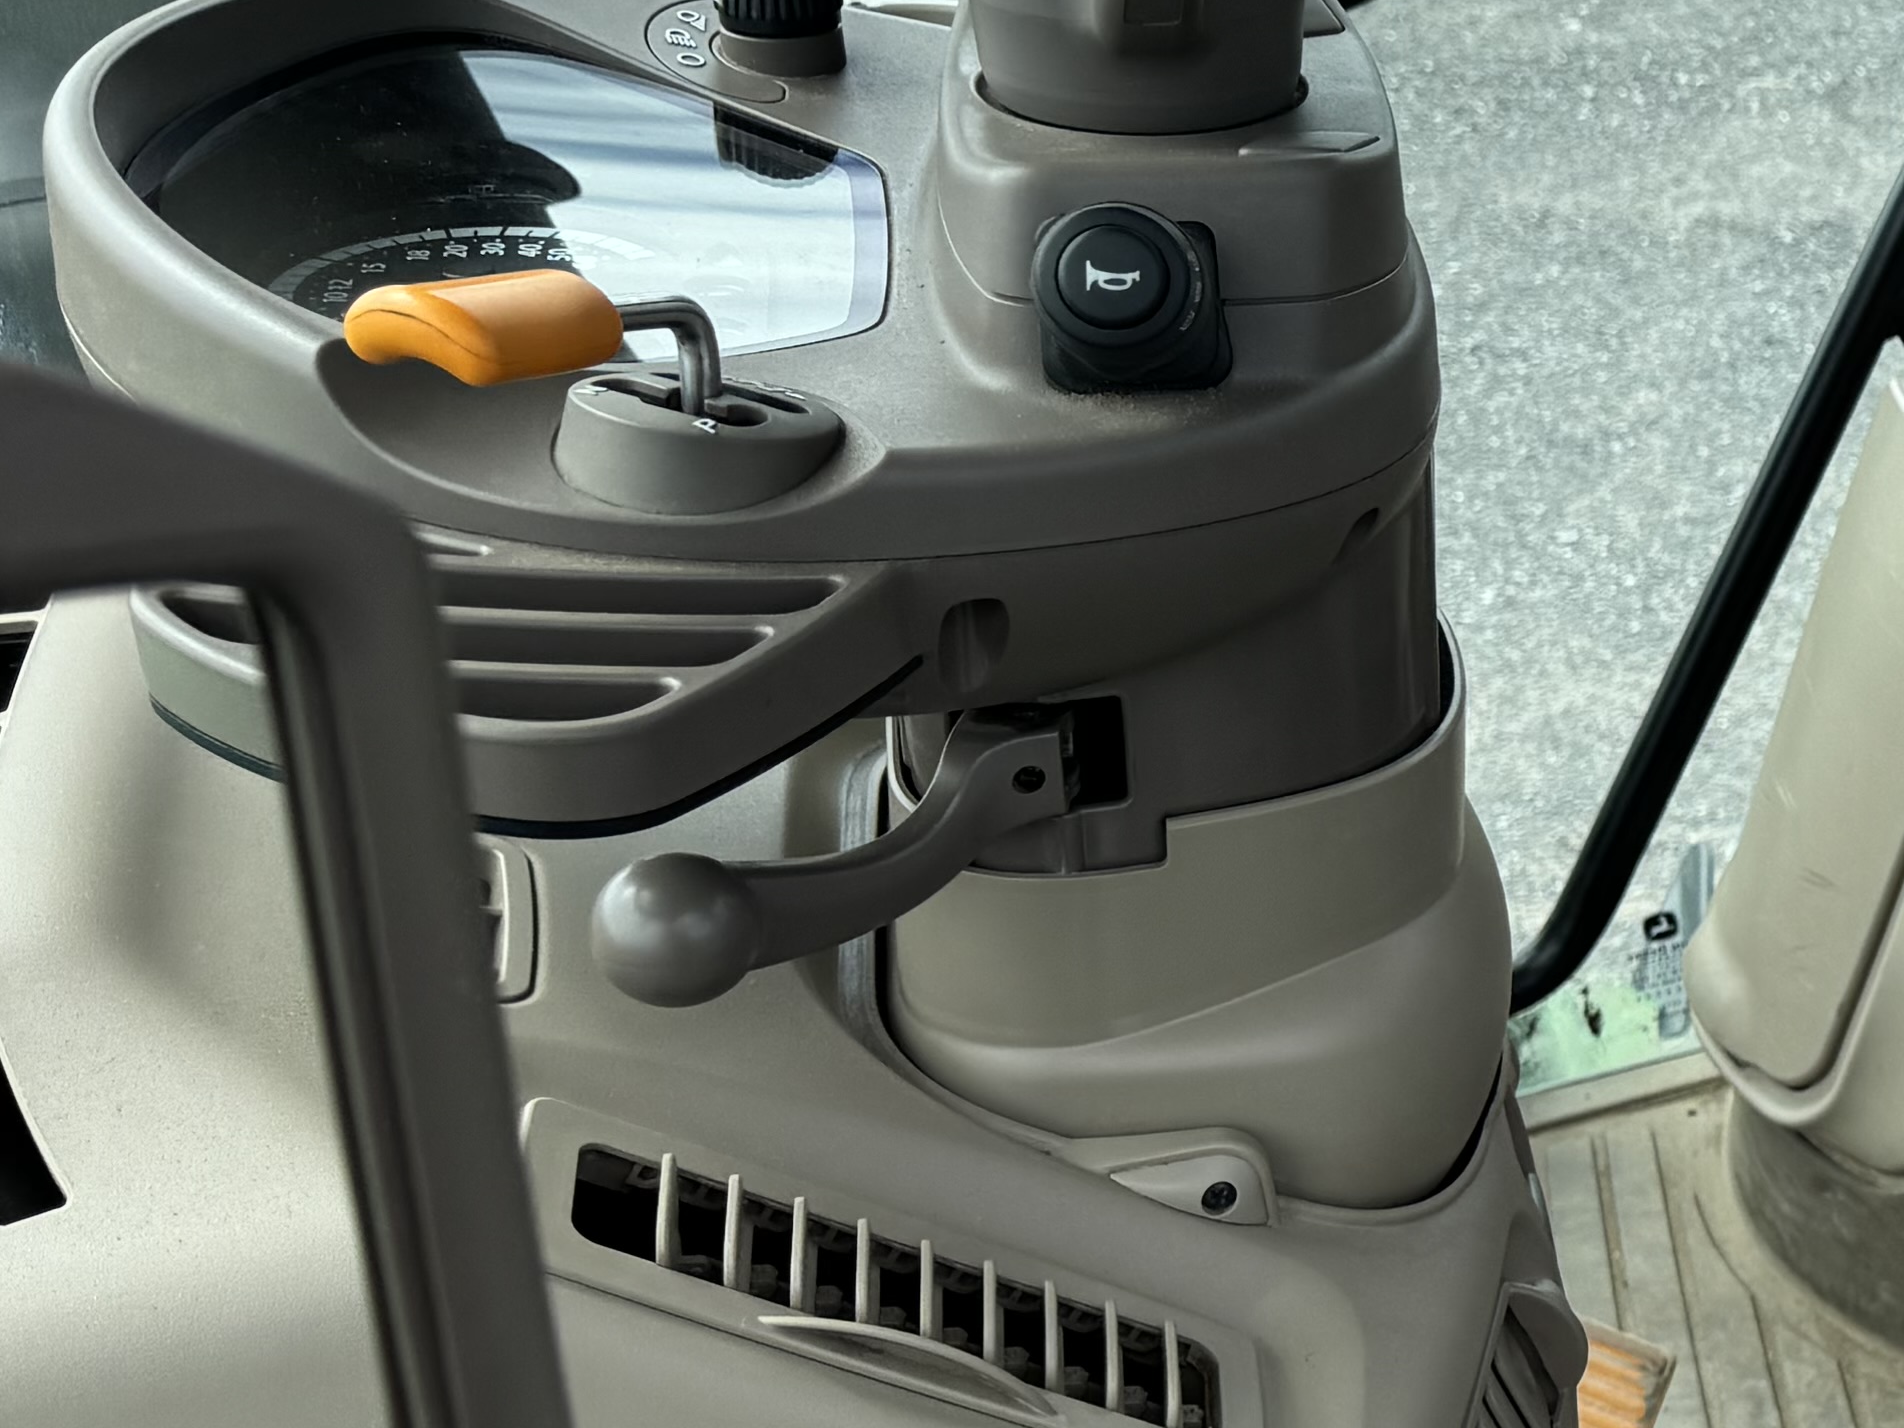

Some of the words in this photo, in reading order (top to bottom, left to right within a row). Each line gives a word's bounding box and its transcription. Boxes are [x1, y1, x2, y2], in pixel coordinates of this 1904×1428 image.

[406, 249, 431, 261] 18
[442, 243, 469, 259] 20
[480, 242, 506, 256] 30
[517, 243, 543, 258] 40
[547, 248, 572, 262] 50
[360, 262, 387, 273] 15
[327, 278, 354, 290] 12
[322, 291, 349, 303] 10
